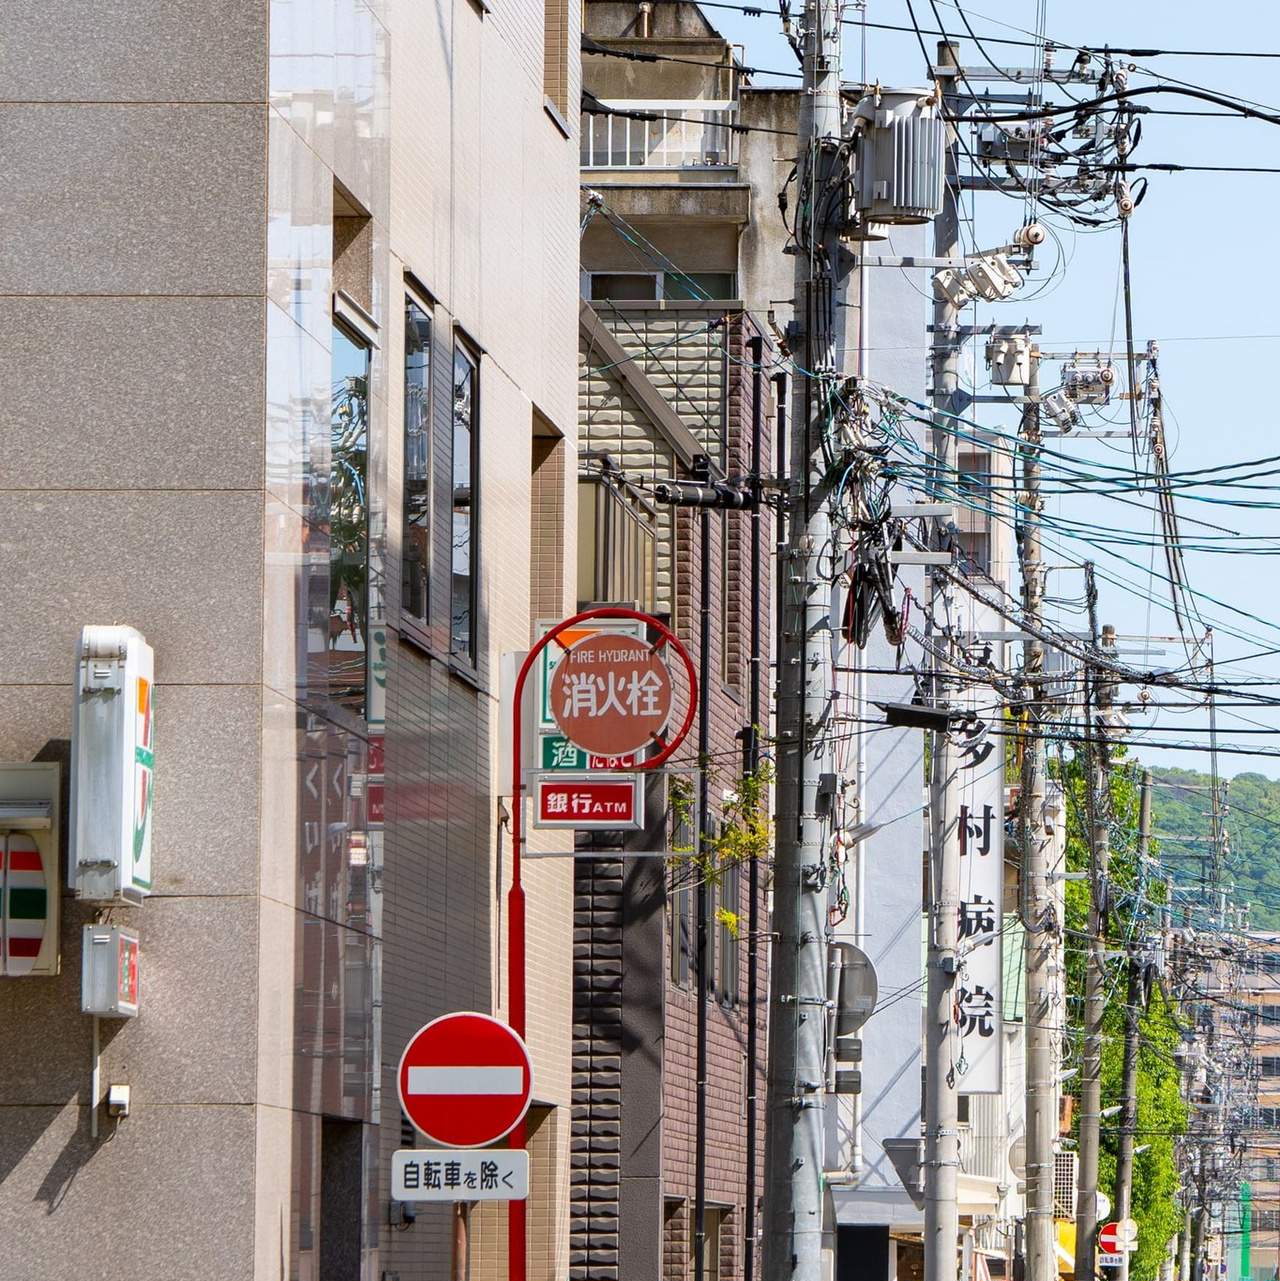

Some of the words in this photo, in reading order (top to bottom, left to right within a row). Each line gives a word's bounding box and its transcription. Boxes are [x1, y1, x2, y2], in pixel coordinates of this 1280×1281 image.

[569, 650, 595, 664] FIRE
[598, 648, 652, 663] HYDRANT
[562, 670, 664, 718] 消火栓
[551, 741, 578, 767] 酒
[547, 792, 627, 815] 銀行ATM
[403, 1160, 514, 1191] 自転車を除く
